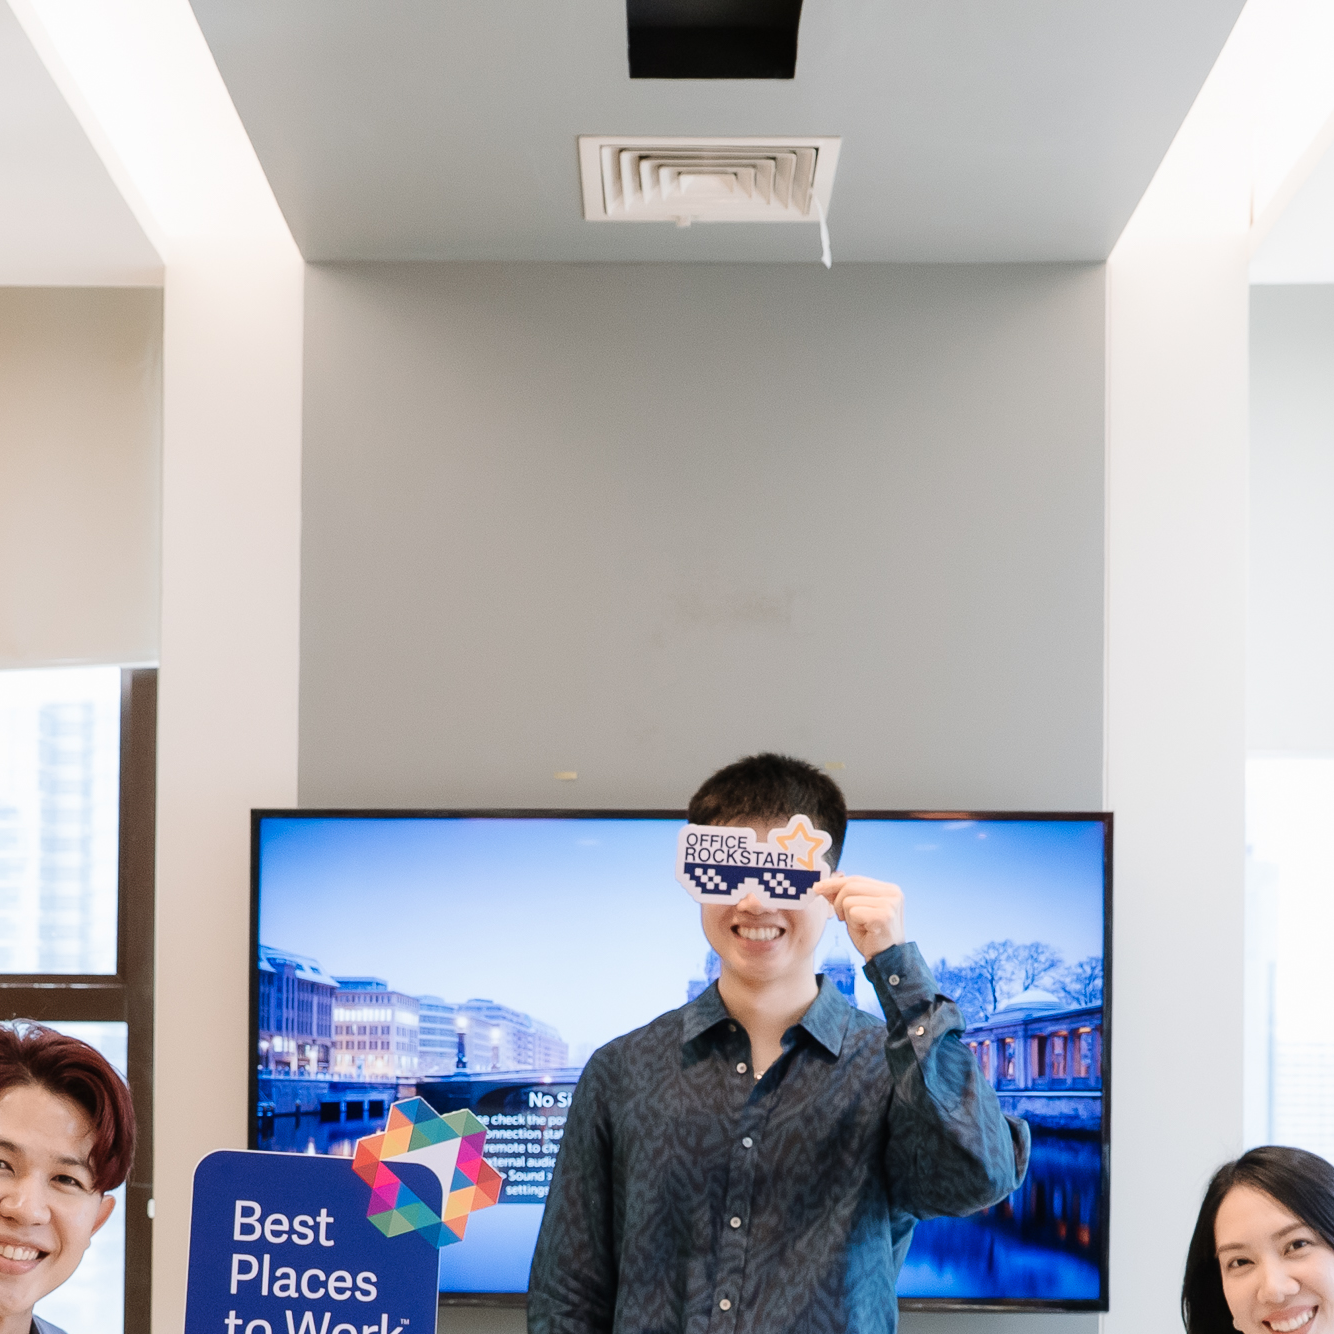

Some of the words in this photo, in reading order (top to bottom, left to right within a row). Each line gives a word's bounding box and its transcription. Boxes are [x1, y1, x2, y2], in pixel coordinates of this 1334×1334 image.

[686, 832, 748, 850] OFFICE
[685, 846, 795, 868] ROCKSTAR!
[528, 1091, 555, 1108] No
[490, 1112, 526, 1126] check
[526, 1113, 547, 1126] the
[486, 1127, 542, 1140] onnection
[526, 1142, 541, 1154] to
[507, 1169, 546, 1181] Sound
[233, 1199, 335, 1248] Best
[229, 1253, 378, 1302] Places
